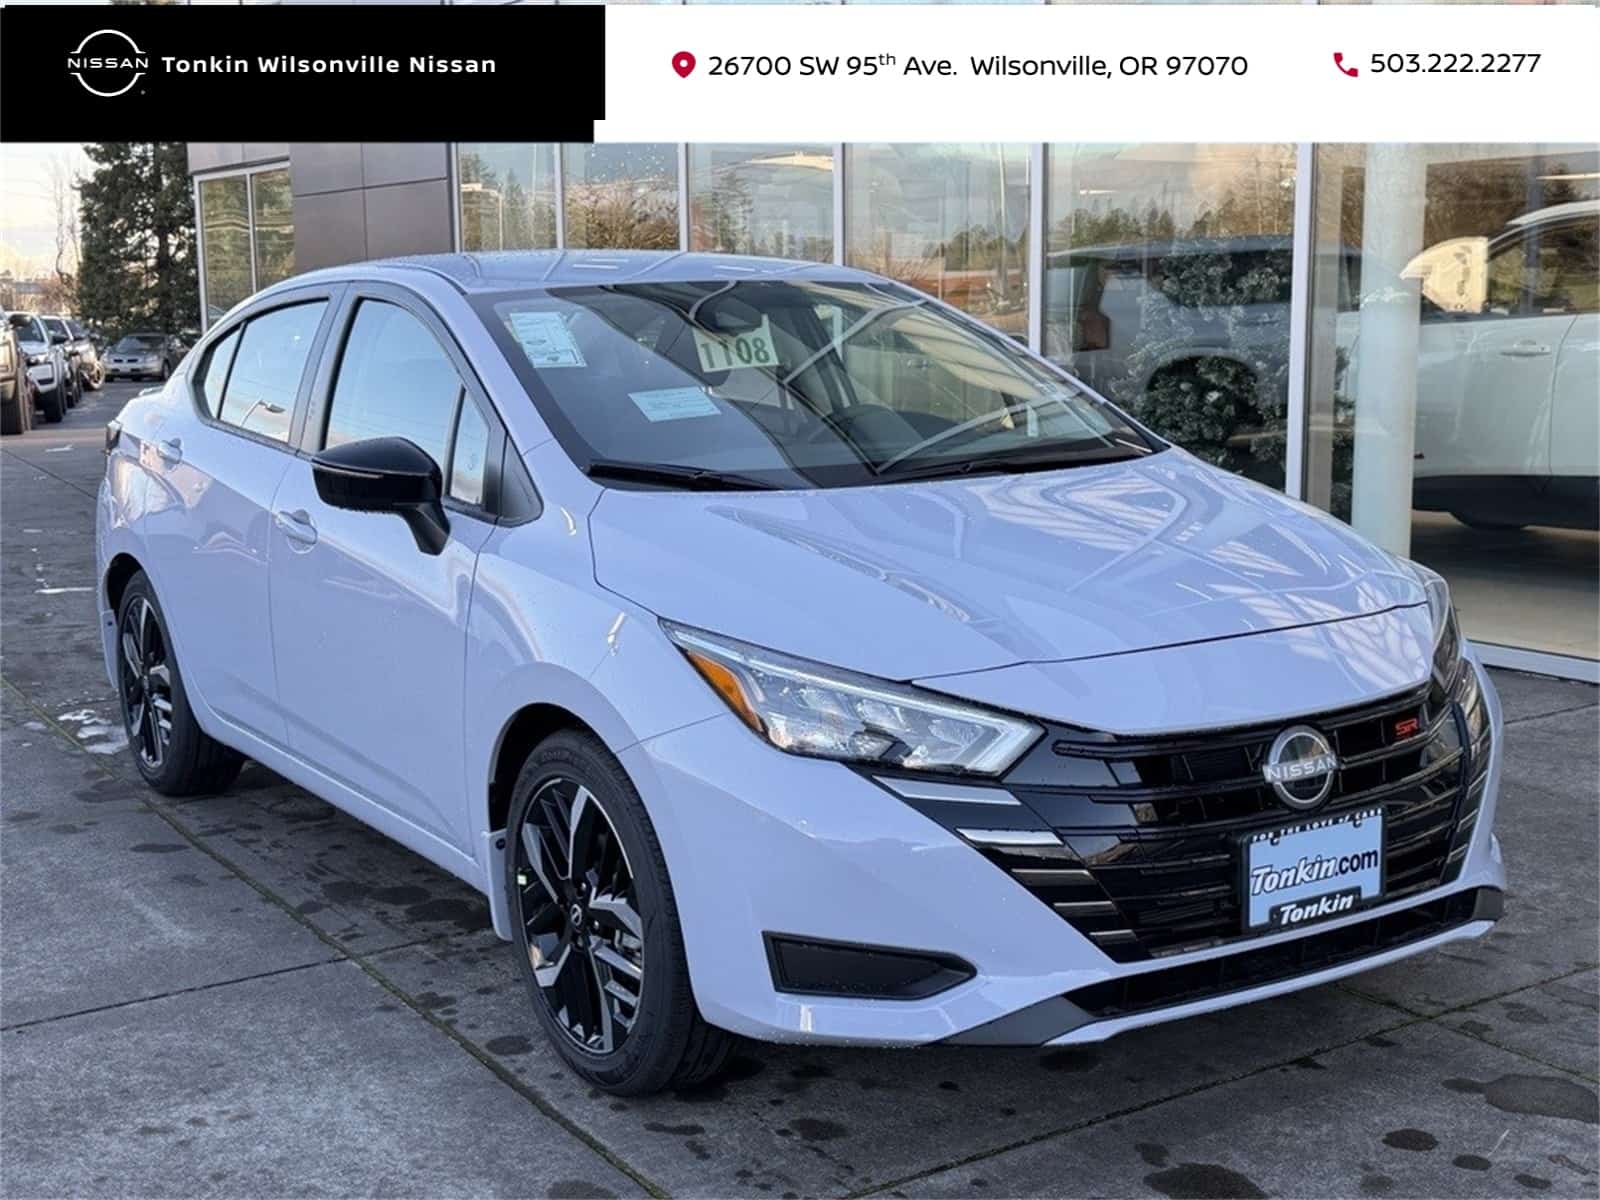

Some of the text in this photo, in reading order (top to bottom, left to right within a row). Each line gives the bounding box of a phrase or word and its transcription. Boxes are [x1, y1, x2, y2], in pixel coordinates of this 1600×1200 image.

[700, 337, 770, 369] 1108
[1395, 717, 1419, 736] SR
[1264, 756, 1338, 780] NISSAN
[1251, 849, 1378, 896] Tonkin.com
[1279, 895, 1355, 925] Tonkin
